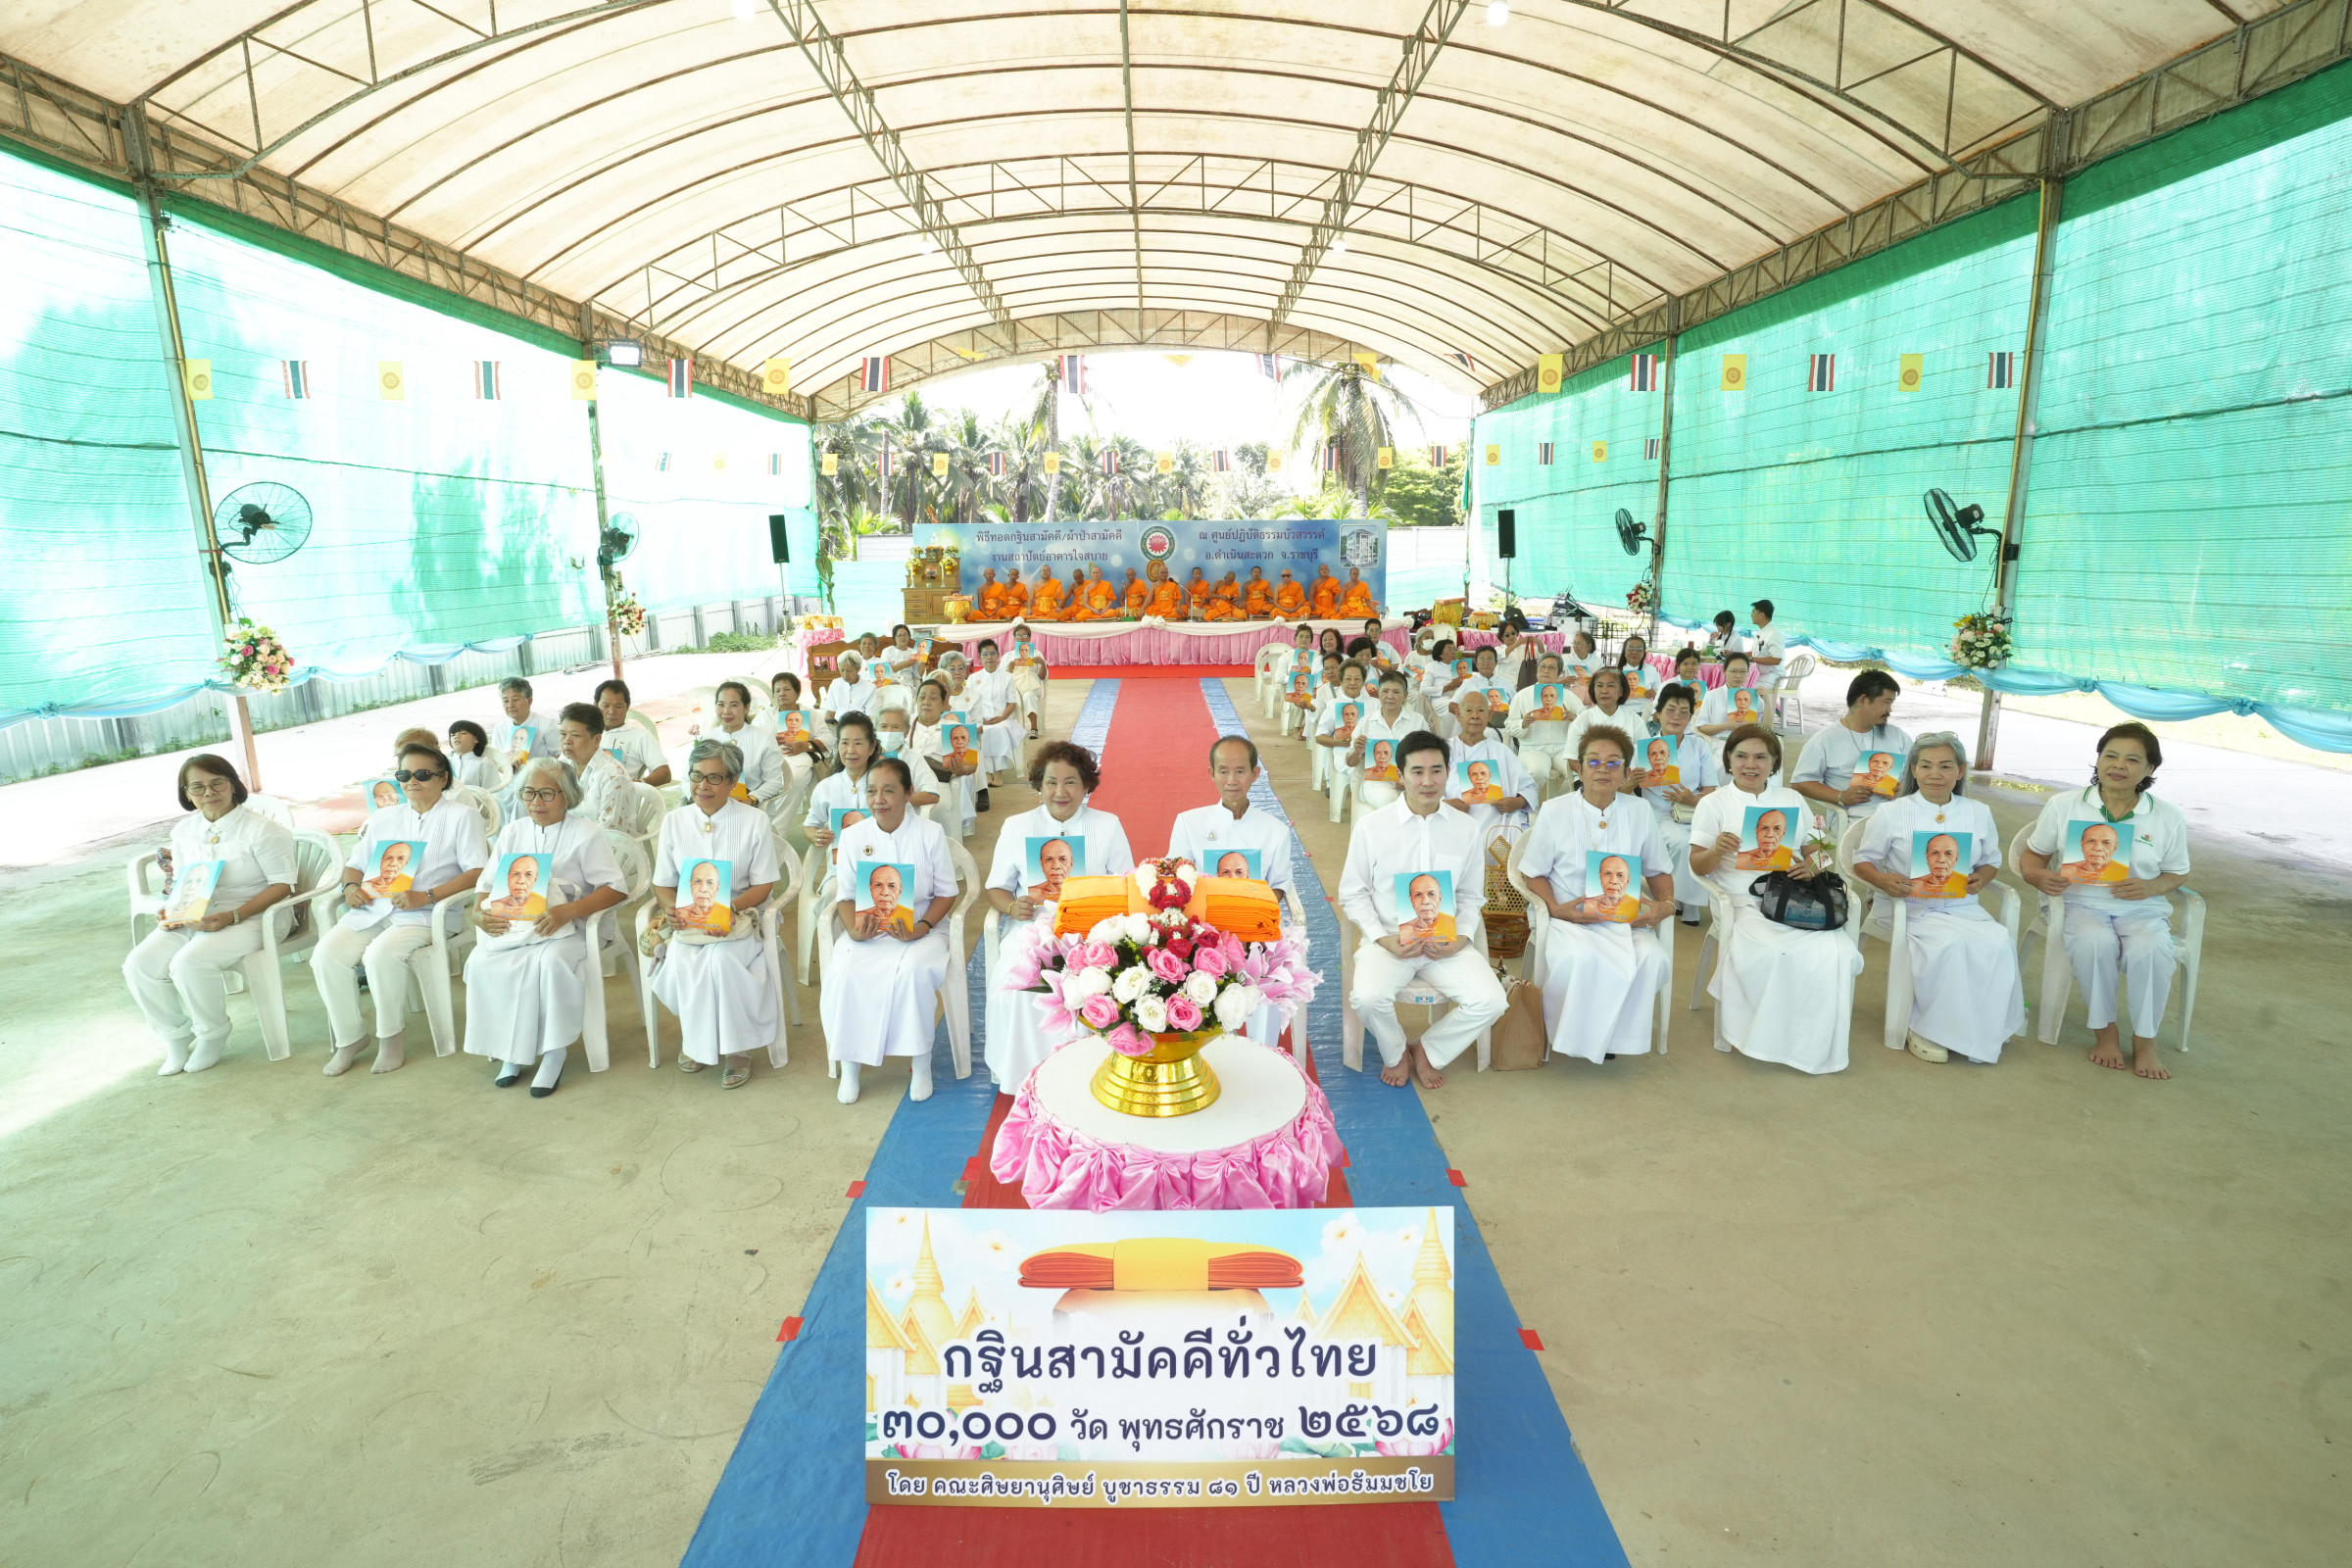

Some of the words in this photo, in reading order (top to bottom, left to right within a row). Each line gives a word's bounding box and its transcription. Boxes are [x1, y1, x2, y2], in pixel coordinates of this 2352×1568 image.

[976, 529, 1122, 544] พิธีทอดกฐินสามัคคี/ผ้าป่าสามัคคี
[1199, 531, 1207, 540] ณ
[1211, 527, 1325, 543] ศูนย์ปฏิบัติธรรมบัวสวรรค์
[992, 549, 1108, 562] งานสถาปัตย์อาคารใจสบาย
[1205, 549, 1274, 561] อ.ดำเนินสะดวก
[1281, 549, 1319, 563] จ.ราชบุรี
[944, 1314, 1376, 1394] กฐินสามัคคีทั่วไทย
[883, 1409, 1056, 1446] ๓๐,๐๐๐
[1070, 1408, 1107, 1440] วัด
[1118, 1407, 1285, 1451] พุทธศักราช
[1298, 1403, 1440, 1439] ๒๕๖๘
[888, 1472, 925, 1493] โดย
[934, 1473, 1095, 1502] คณะศิษยานุศิษย์
[1103, 1479, 1200, 1502] บูชาธรรม
[1208, 1480, 1238, 1495] ๘๑
[1246, 1473, 1261, 1494] ปี
[1268, 1470, 1433, 1494] หลวงพ่อธัมมชโย
